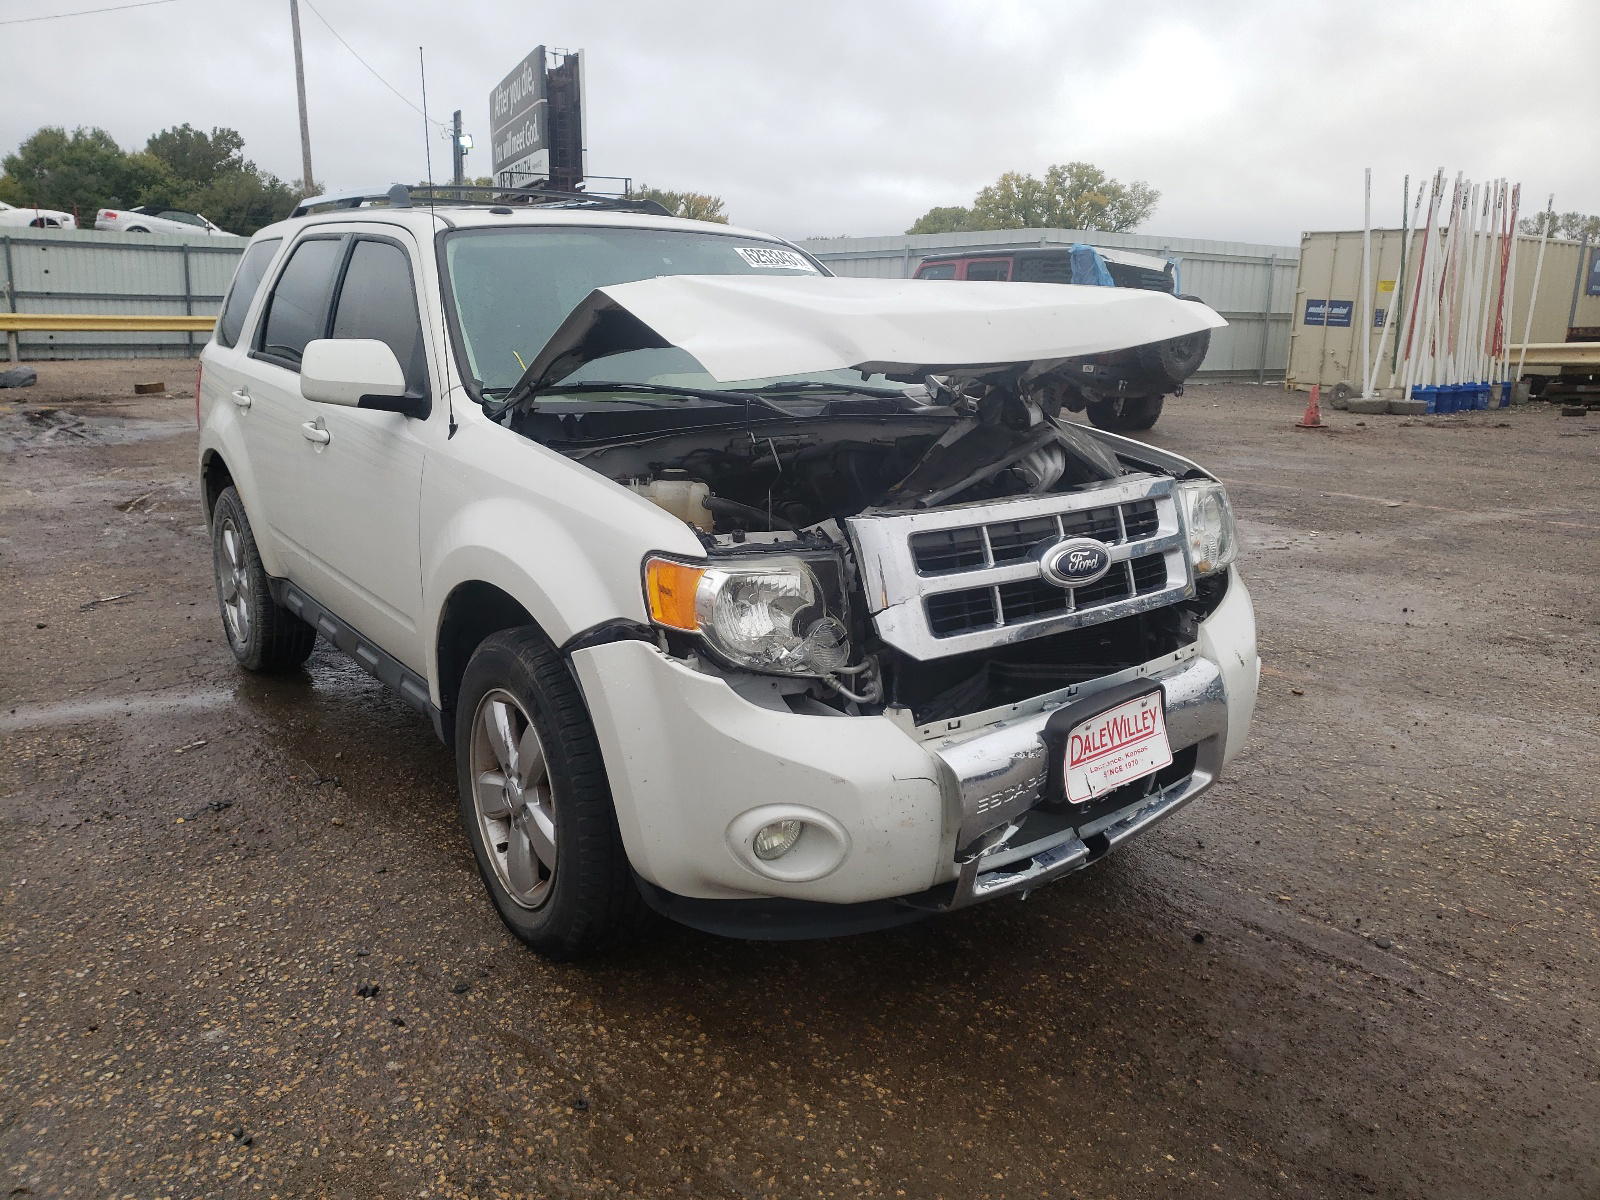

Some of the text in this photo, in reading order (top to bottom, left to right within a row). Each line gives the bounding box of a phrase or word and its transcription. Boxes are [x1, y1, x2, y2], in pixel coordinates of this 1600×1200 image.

[510, 77, 521, 116] you
[1069, 551, 1099, 573] Ford
[1125, 759, 1139, 770] 1970
